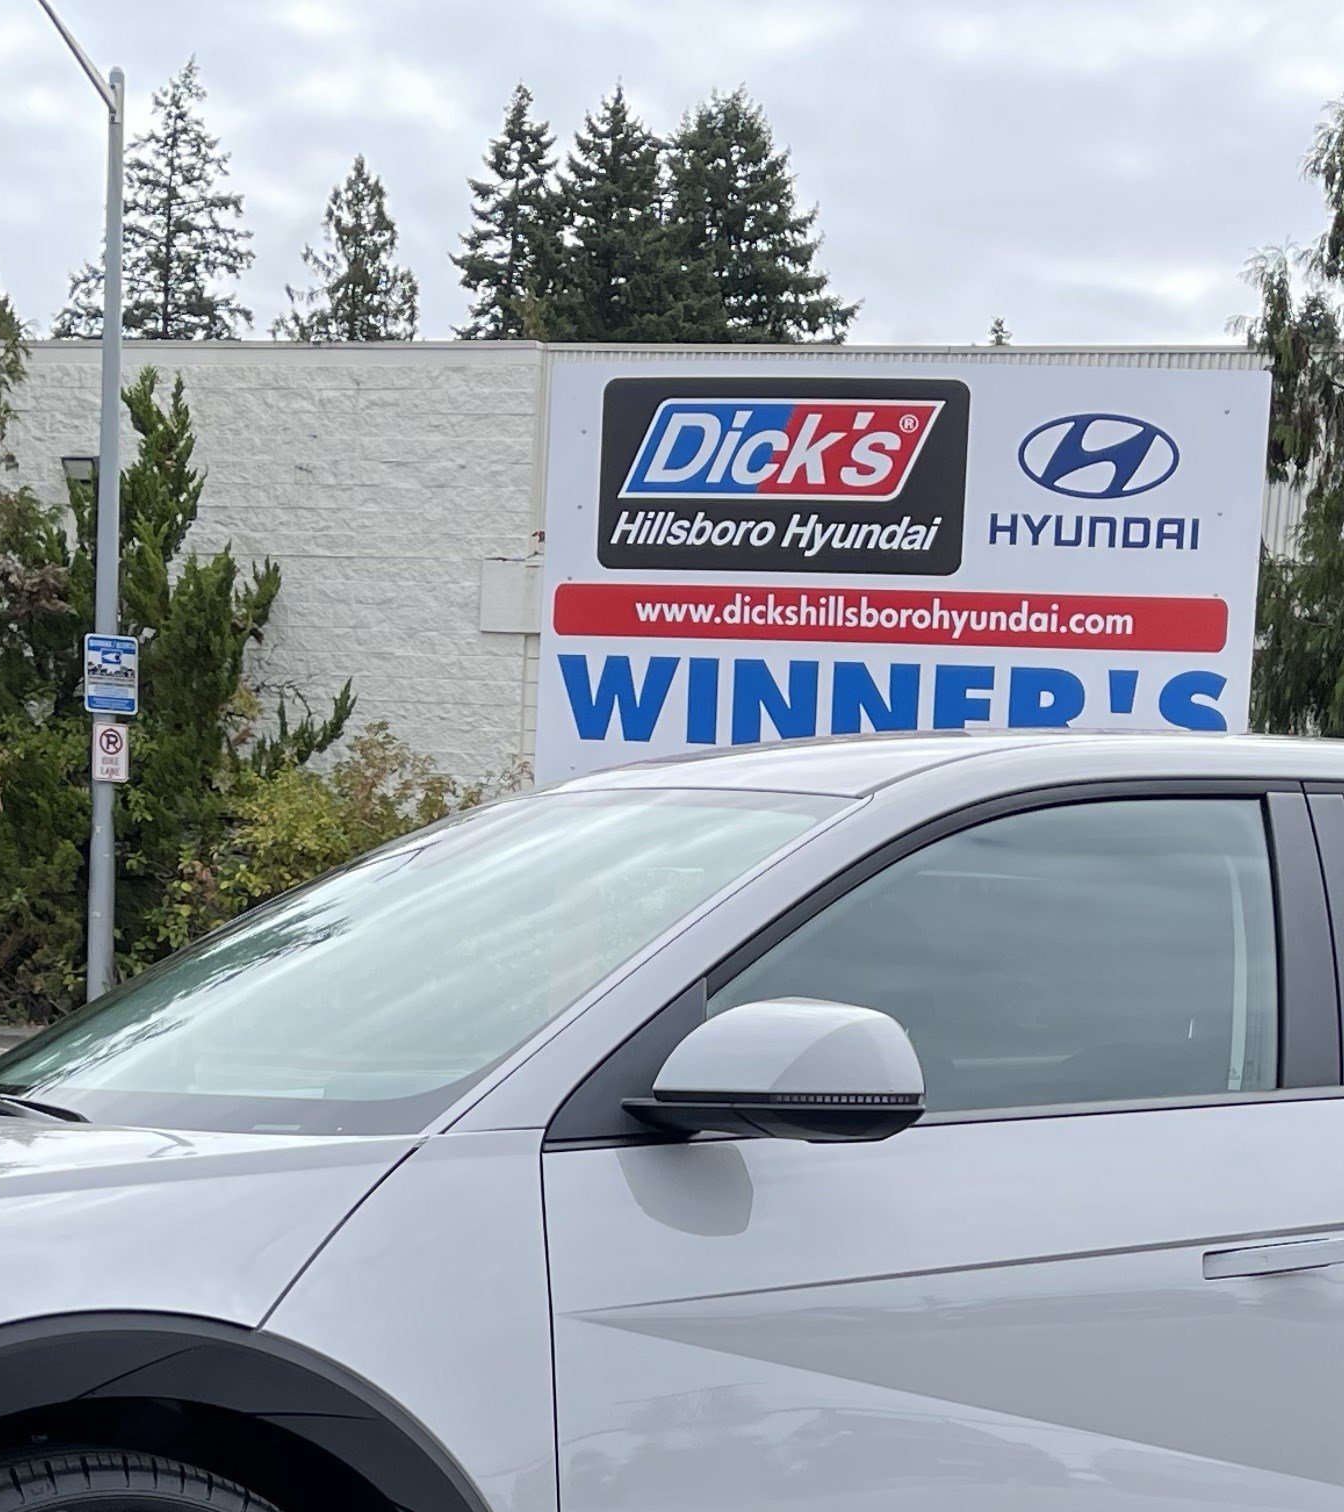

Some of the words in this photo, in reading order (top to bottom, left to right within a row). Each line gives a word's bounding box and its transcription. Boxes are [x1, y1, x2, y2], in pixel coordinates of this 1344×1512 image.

[643, 410, 902, 487] Dick's
[610, 511, 775, 546] Hillsboro
[781, 513, 942, 556] Hyundai
[989, 513, 1200, 550] HYUNDAI
[635, 594, 1133, 639] www.dickshillsborohyundai.com
[557, 653, 1228, 746] WINNER'S
